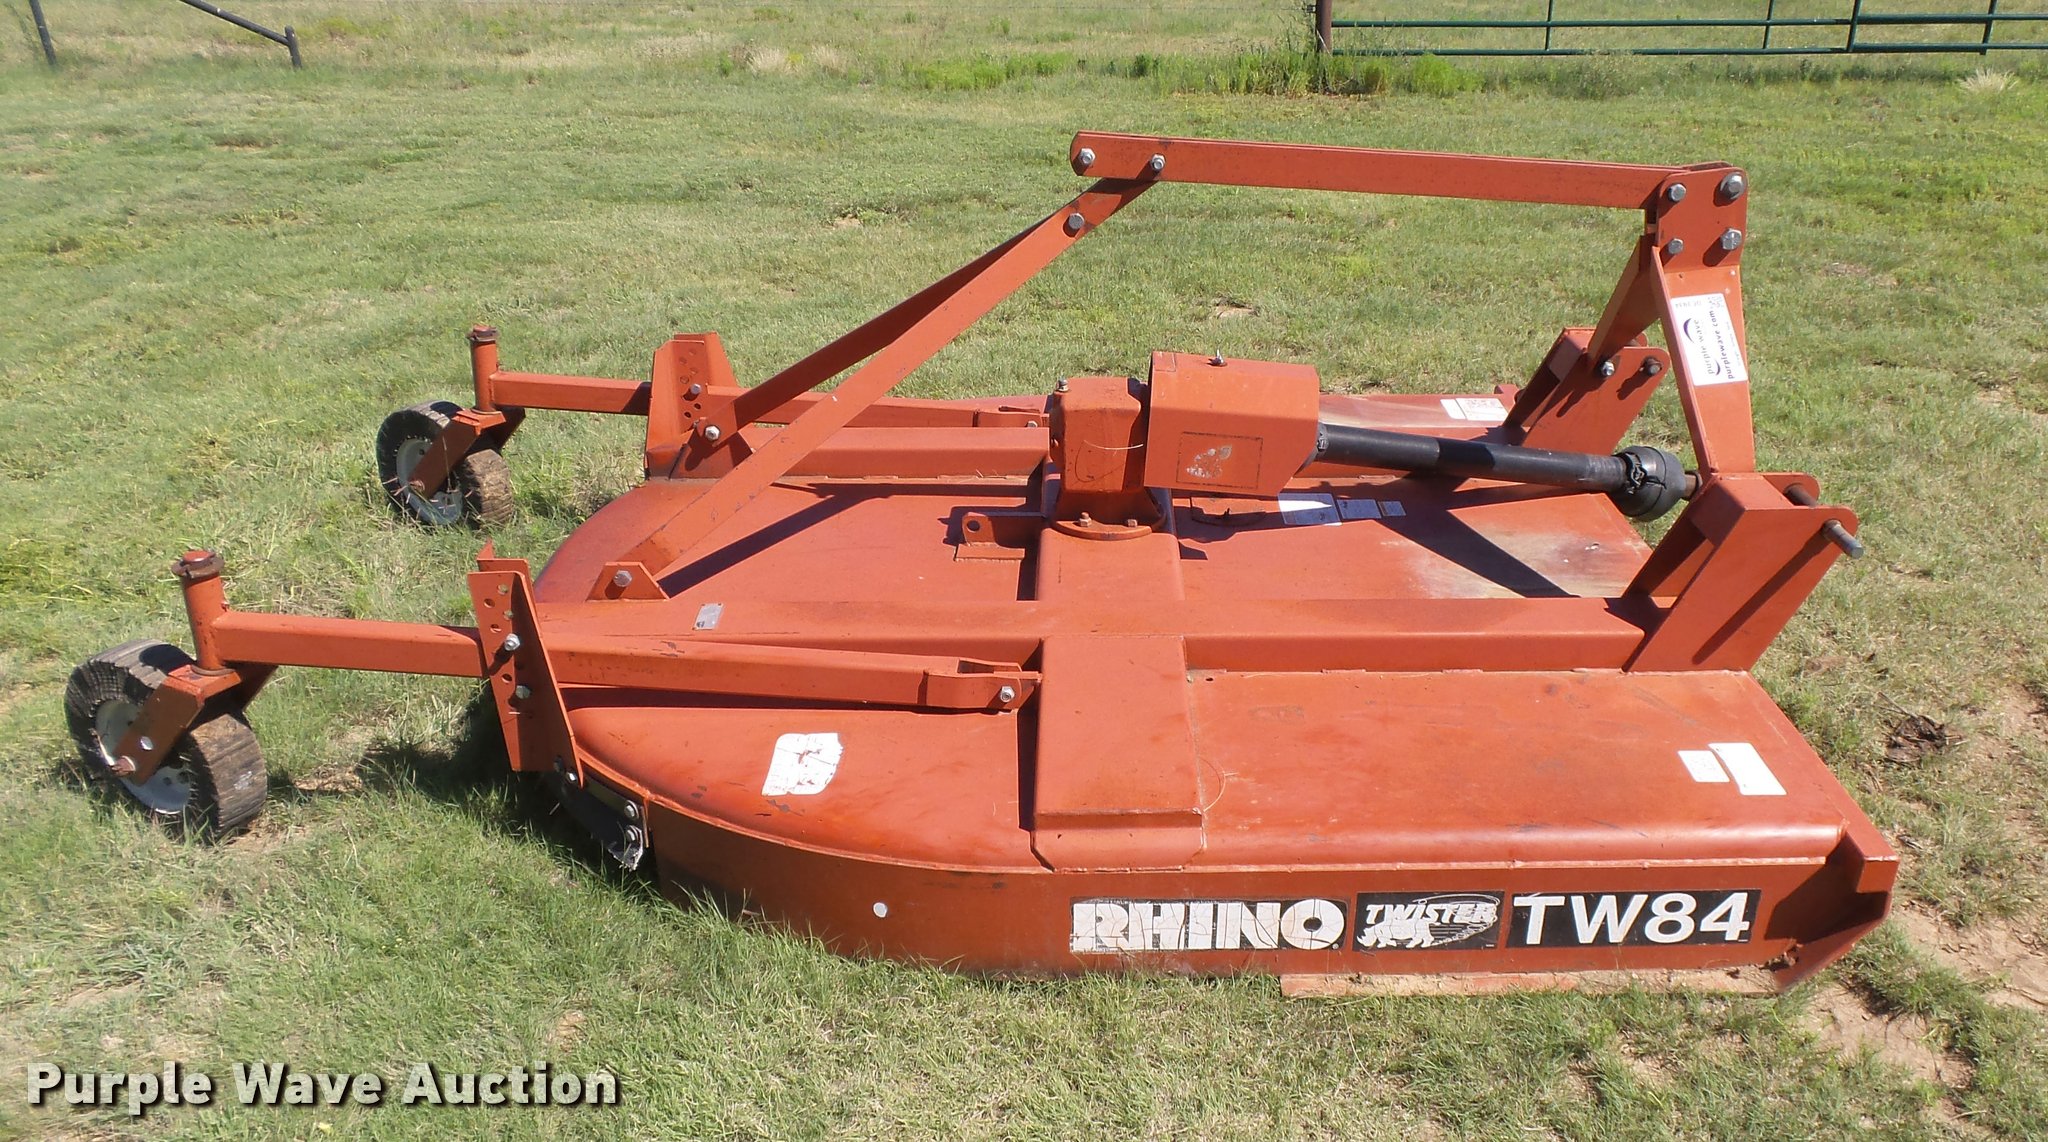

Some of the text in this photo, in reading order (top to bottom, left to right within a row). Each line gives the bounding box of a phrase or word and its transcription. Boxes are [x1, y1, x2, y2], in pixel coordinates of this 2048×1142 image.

[1693, 319, 1715, 375] purple wave
[1709, 310, 1735, 379] purplewavecom
[1073, 899, 1344, 951] RHINO
[1366, 904, 1498, 924] TWISTER
[1513, 892, 1750, 944] TW84
